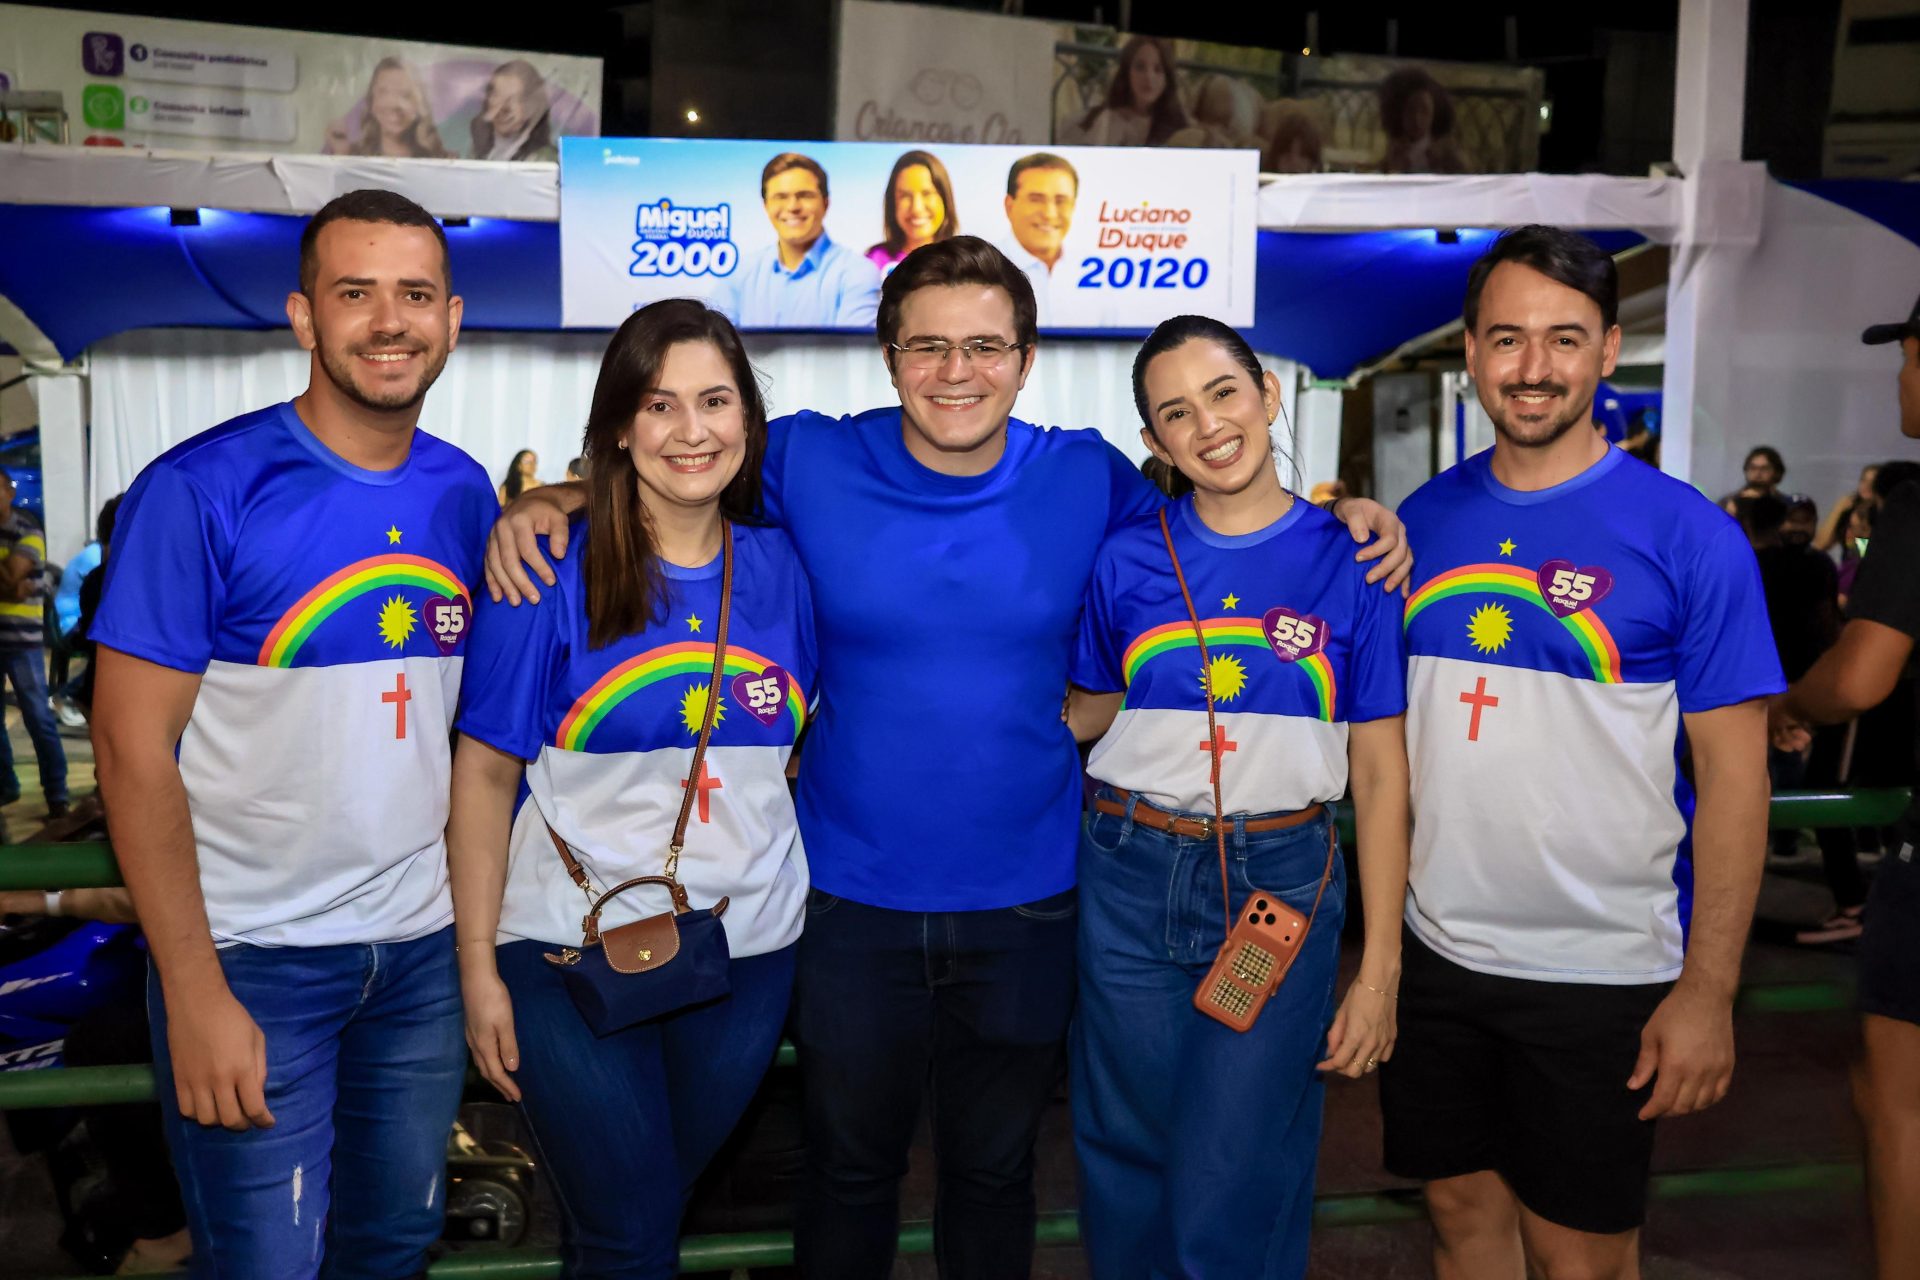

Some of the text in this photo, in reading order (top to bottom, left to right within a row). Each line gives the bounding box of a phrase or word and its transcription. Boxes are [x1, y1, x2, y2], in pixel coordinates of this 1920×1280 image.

[639, 201, 729, 238] Miguel
[1098, 201, 1191, 224] Luciano
[1098, 228, 1188, 252] Duque
[631, 241, 737, 275] 2000
[1078, 257, 1209, 288] 20120
[1548, 569, 1596, 601] 55
[434, 605, 465, 634] 55
[1272, 615, 1316, 649] 55
[745, 677, 782, 708] 55
